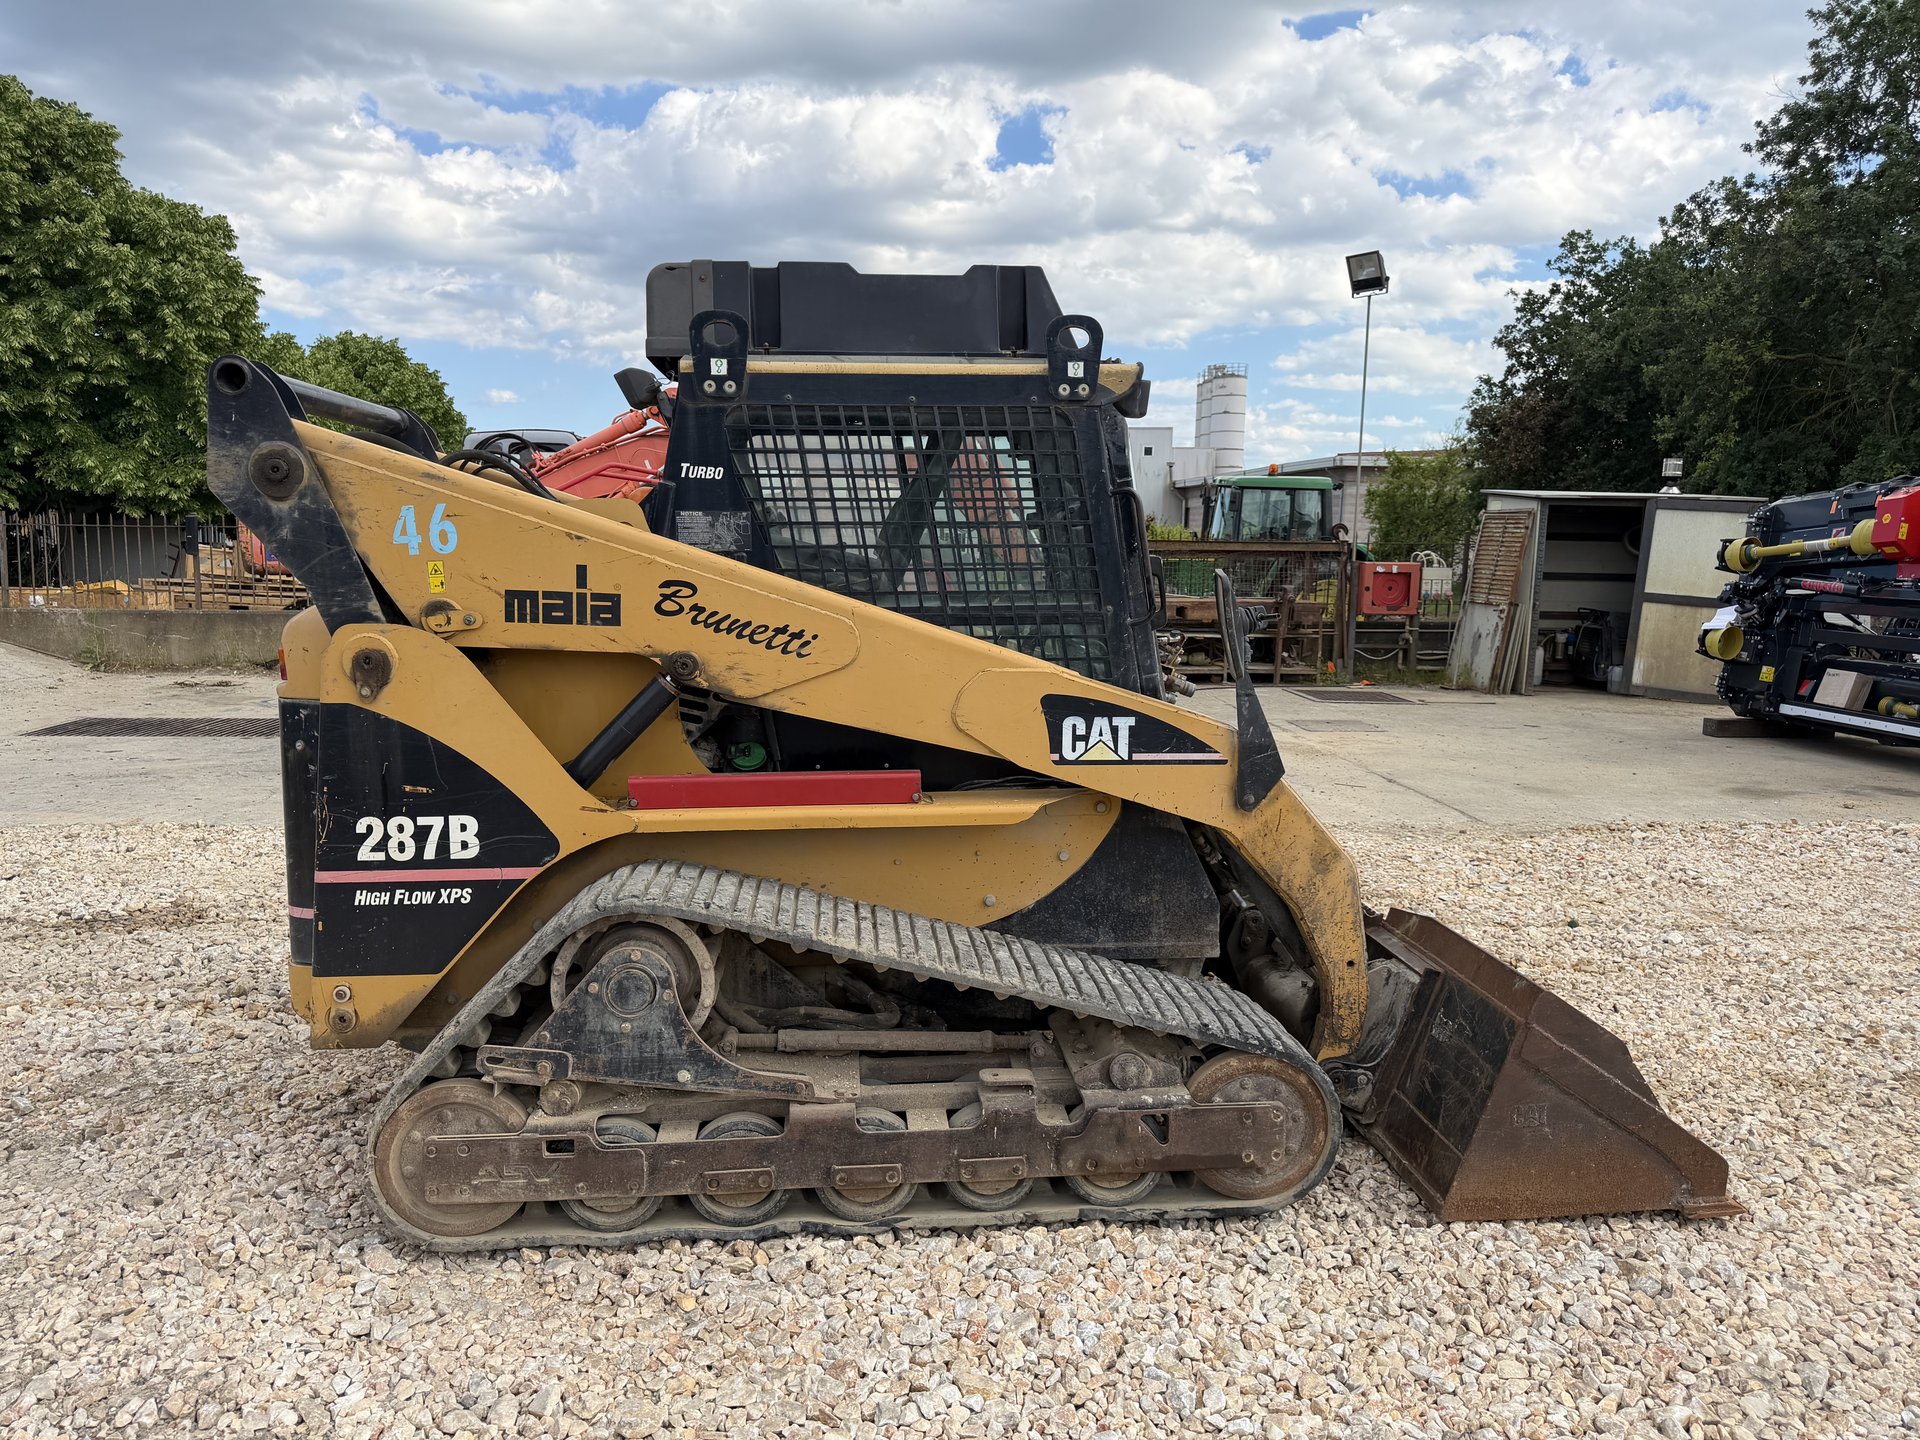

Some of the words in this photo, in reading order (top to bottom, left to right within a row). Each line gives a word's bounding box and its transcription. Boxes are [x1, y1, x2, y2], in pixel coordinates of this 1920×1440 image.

[680, 462, 724, 480] TURBO
[392, 503, 458, 556] 46
[654, 579, 819, 659] Brunetti
[1061, 715, 1136, 761] CAT
[355, 815, 480, 862] 287B
[437, 887, 473, 904] XPS
